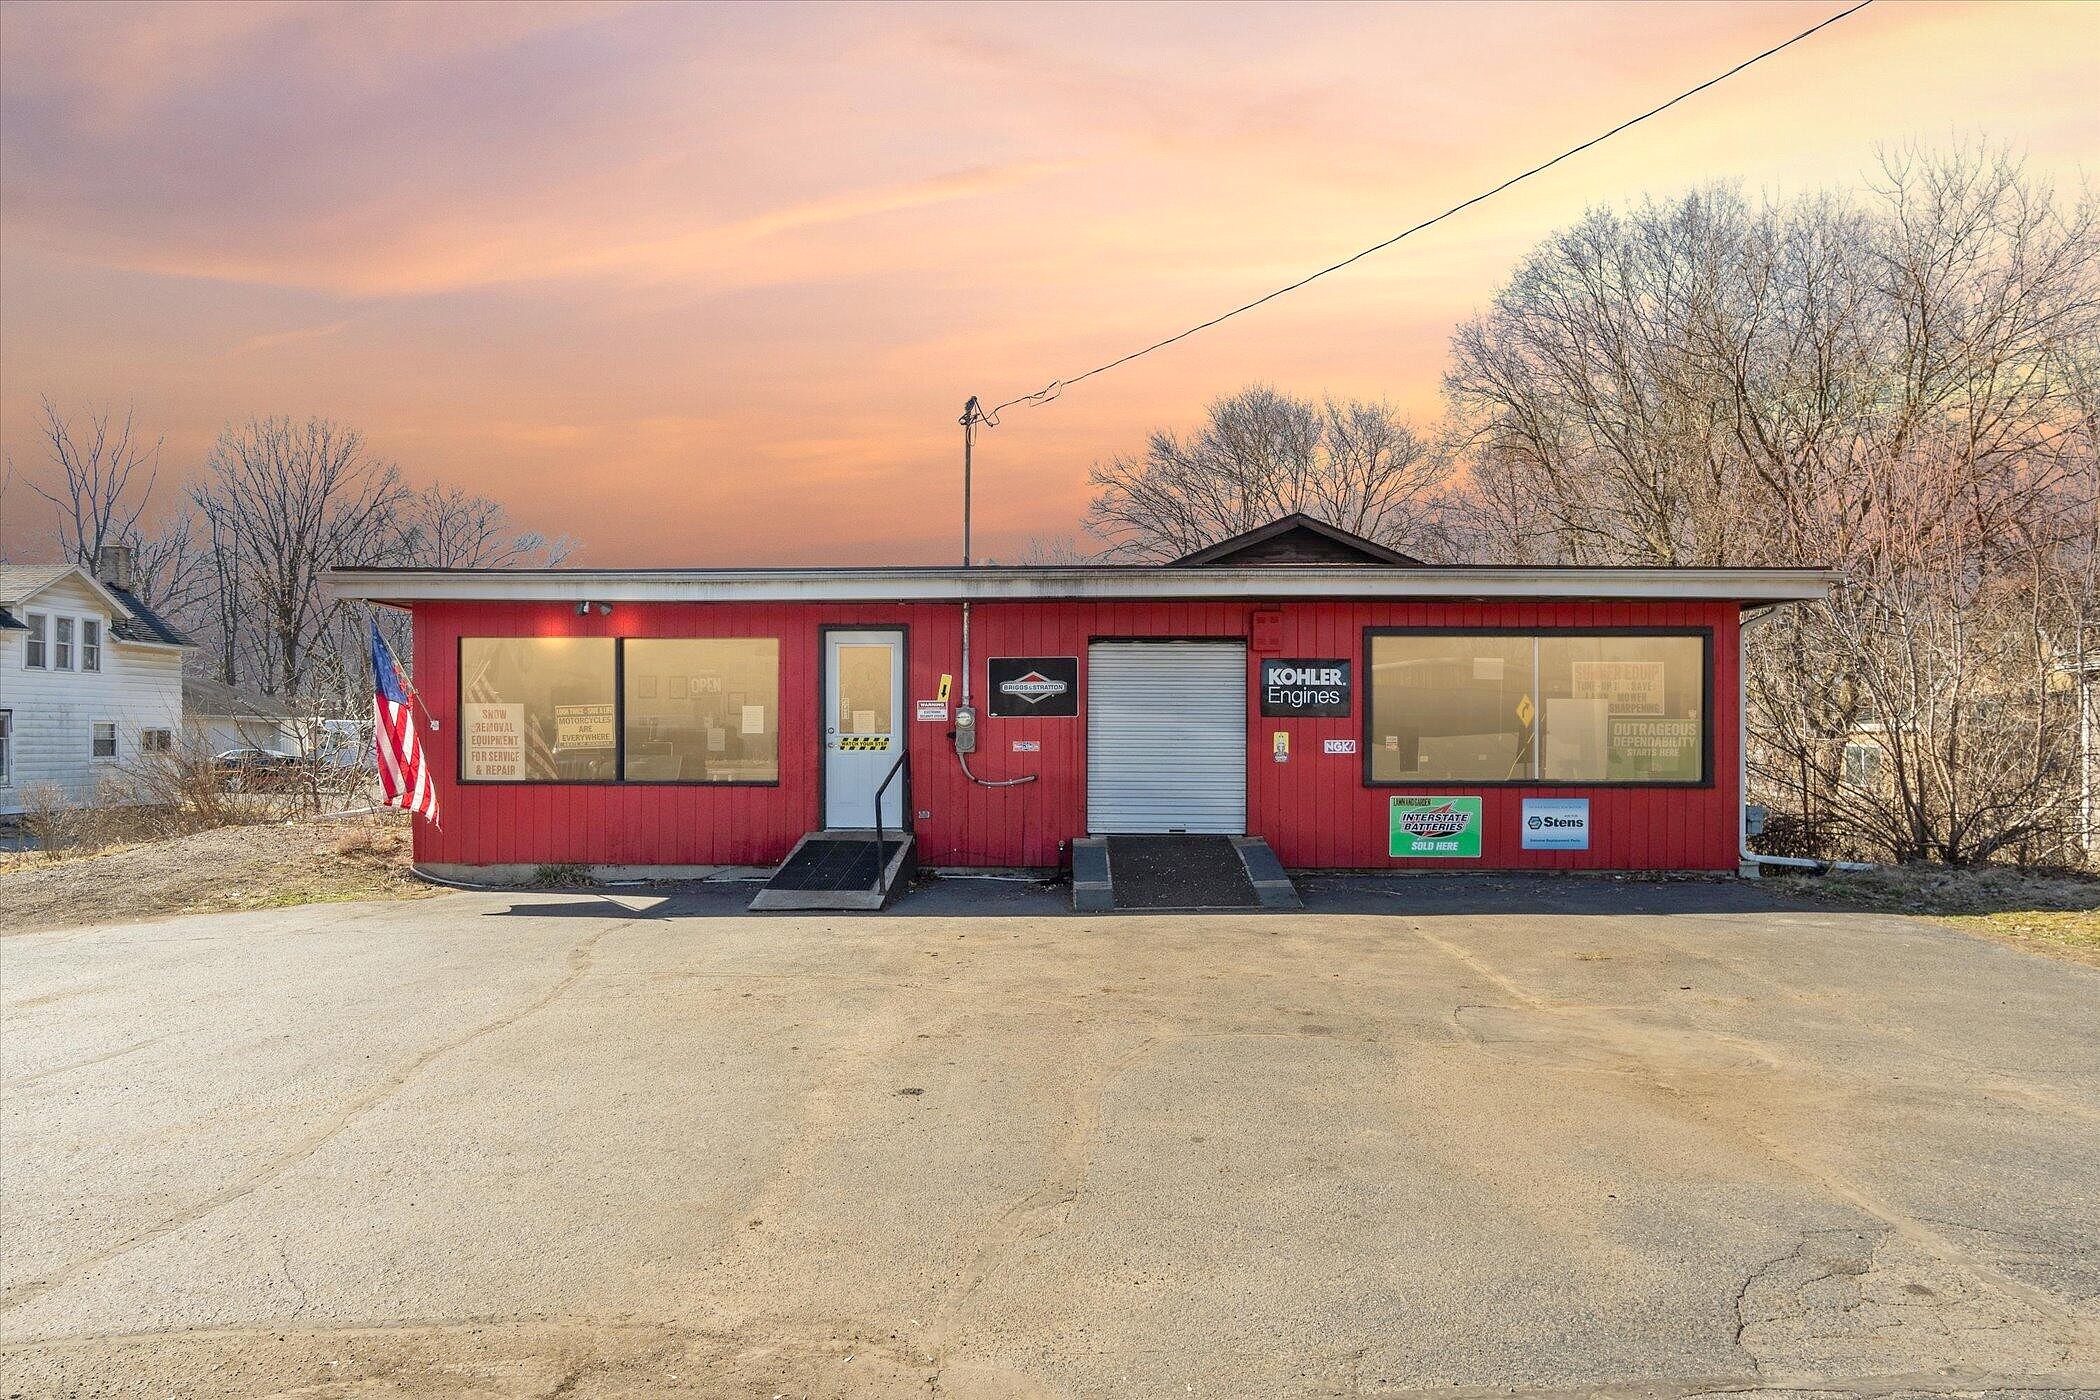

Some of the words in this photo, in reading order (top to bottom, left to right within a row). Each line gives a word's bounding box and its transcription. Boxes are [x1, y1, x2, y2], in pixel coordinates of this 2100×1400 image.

[691, 678, 722, 693] OPEN
[1268, 686, 1341, 708] Engines
[482, 709, 508, 720] SNOW
[558, 716, 612, 725] MOTORCYCLES
[474, 722, 515, 733] REMOVAL
[579, 725, 594, 733] ARE
[1613, 722, 1697, 736] OUTRAGEOUS
[471, 735, 519, 747] EQUIPMENT
[562, 733, 611, 742] EVERYWHERE
[1612, 736, 1697, 748] DEPENDABILITY
[471, 751, 487, 762] FOR
[488, 751, 521, 762] SERVICE
[1626, 748, 1657, 757] STARTS
[1660, 748, 1681, 757] HERE
[475, 764, 482, 776] &
[486, 764, 516, 776] REPAIR
[1402, 813, 1469, 822] INTERSTATE
[1543, 816, 1585, 828] Stens
[1404, 823, 1464, 831] BATTERIES
[1411, 841, 1434, 851] SOLD
[1436, 841, 1459, 851] HERE
